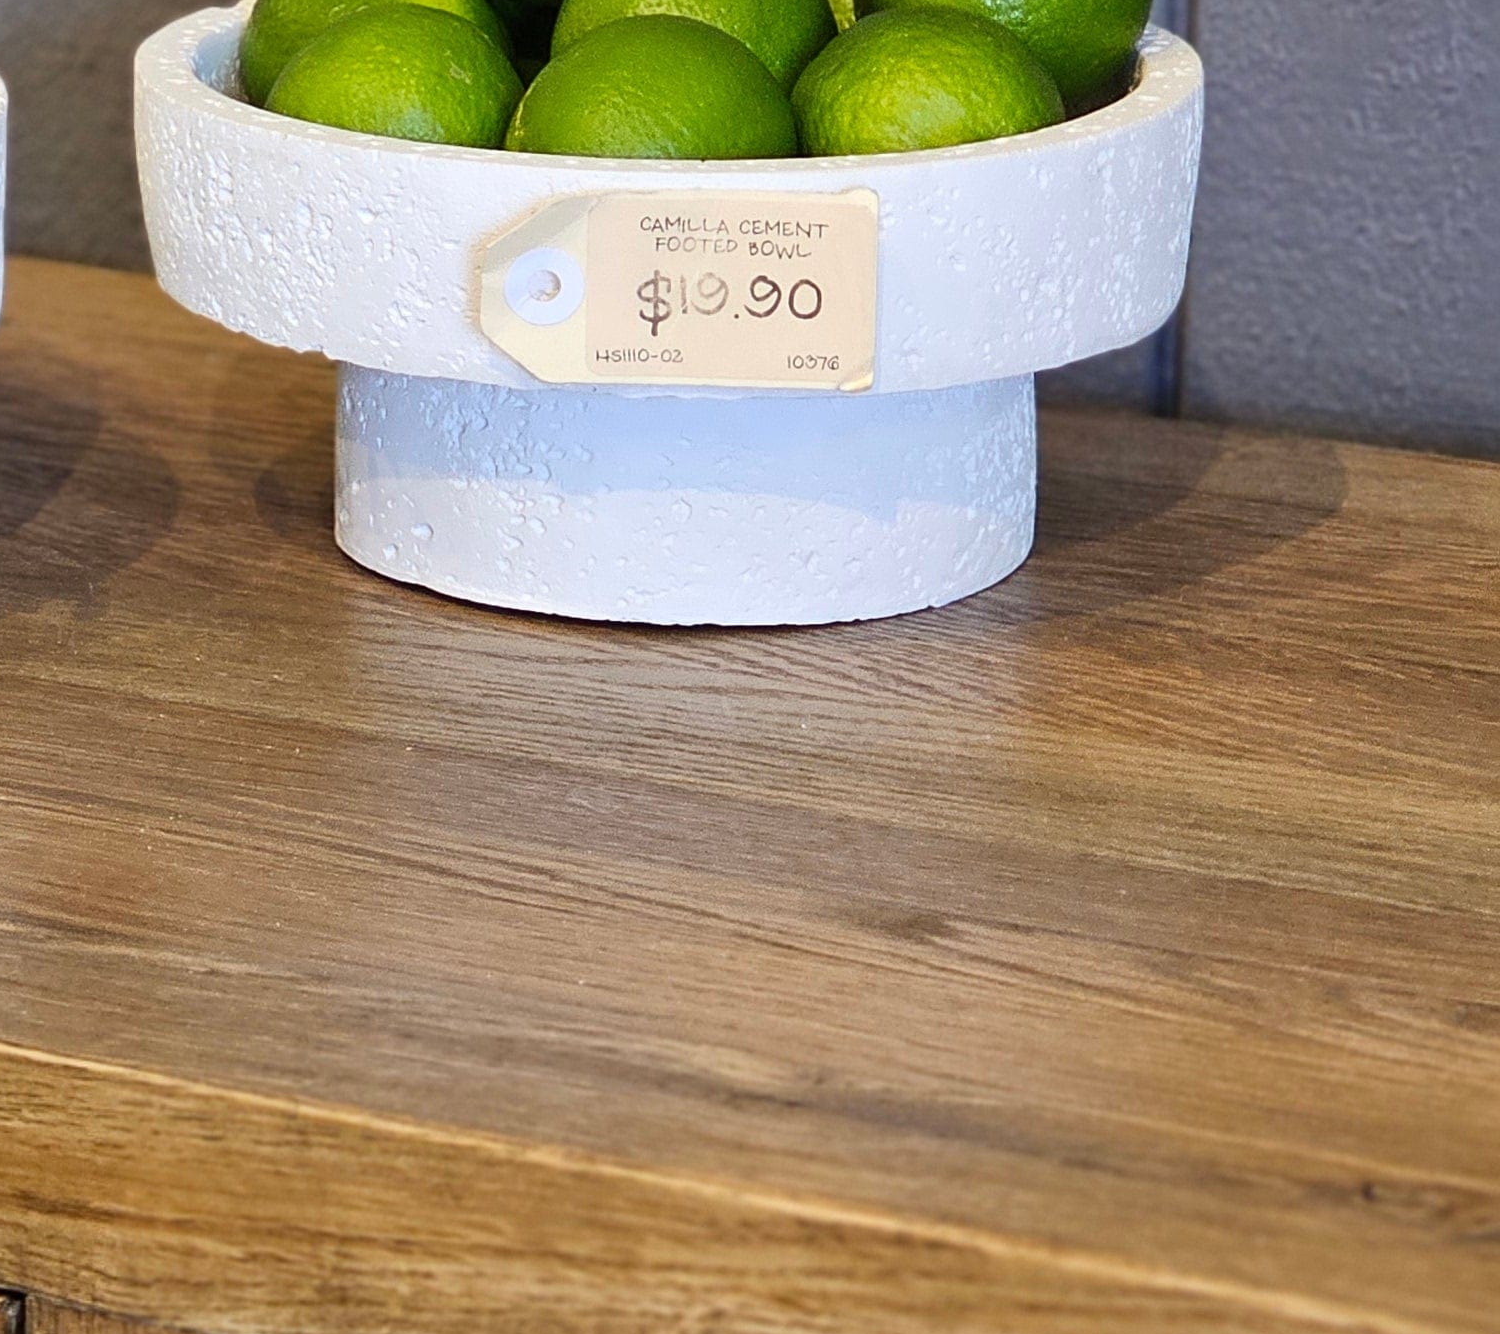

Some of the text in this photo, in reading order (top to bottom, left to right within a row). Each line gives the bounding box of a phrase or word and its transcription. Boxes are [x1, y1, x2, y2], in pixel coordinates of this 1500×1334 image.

[640, 216, 830, 239] CAMILLA CEMENT
[655, 236, 812, 258] FOOTED BOWL
[636, 269, 823, 336] $19.90
[786, 354, 840, 371] 10376
